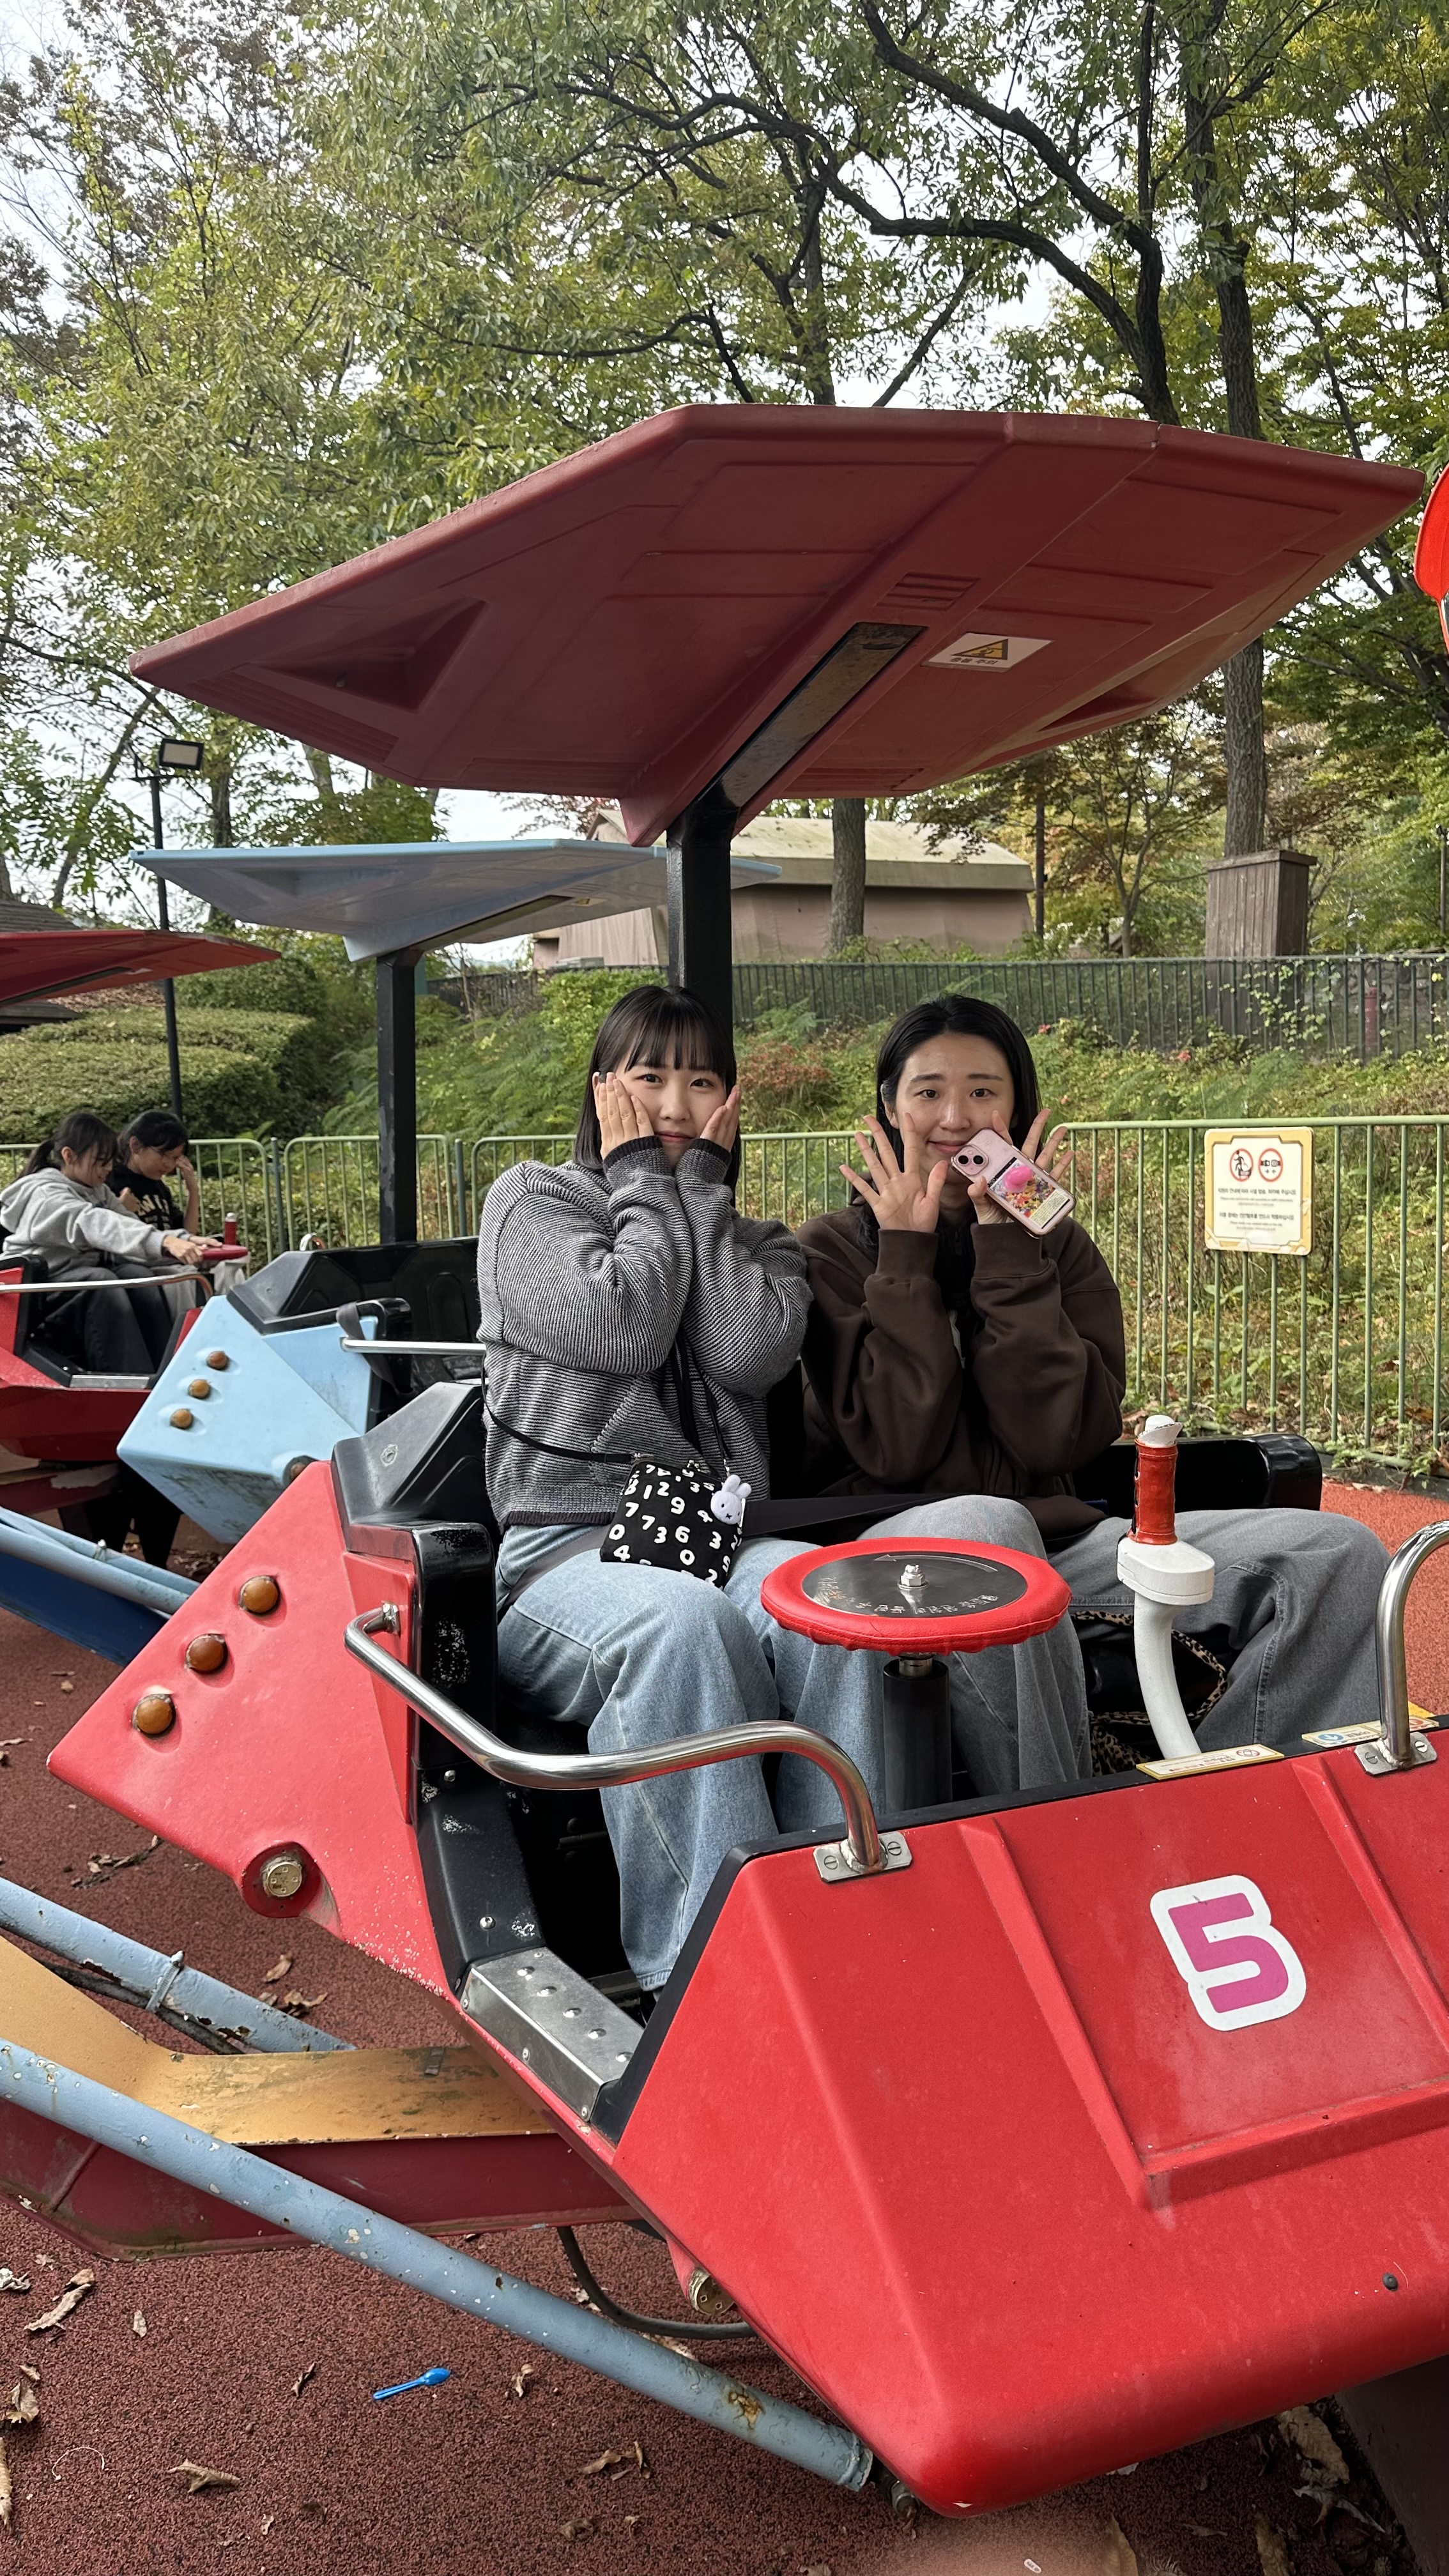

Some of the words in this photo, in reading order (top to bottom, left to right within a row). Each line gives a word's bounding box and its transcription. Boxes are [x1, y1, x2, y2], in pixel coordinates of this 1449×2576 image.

[643, 1485, 652, 1499] 1
[657, 1482, 670, 1496] 2
[690, 1482, 700, 1493] 3
[625, 1502, 639, 1517] 7
[671, 1497, 686, 1515] 9
[642, 1515, 656, 1530] 7
[697, 1510, 713, 1522] 4
[609, 1524, 625, 1540] 0
[654, 1526, 668, 1544] 3
[675, 1526, 691, 1543] 6
[709, 1531, 722, 1549] 3
[613, 1545, 631, 1561] 4
[679, 1549, 695, 1565] 0
[1167, 1892, 1289, 2014] 5
